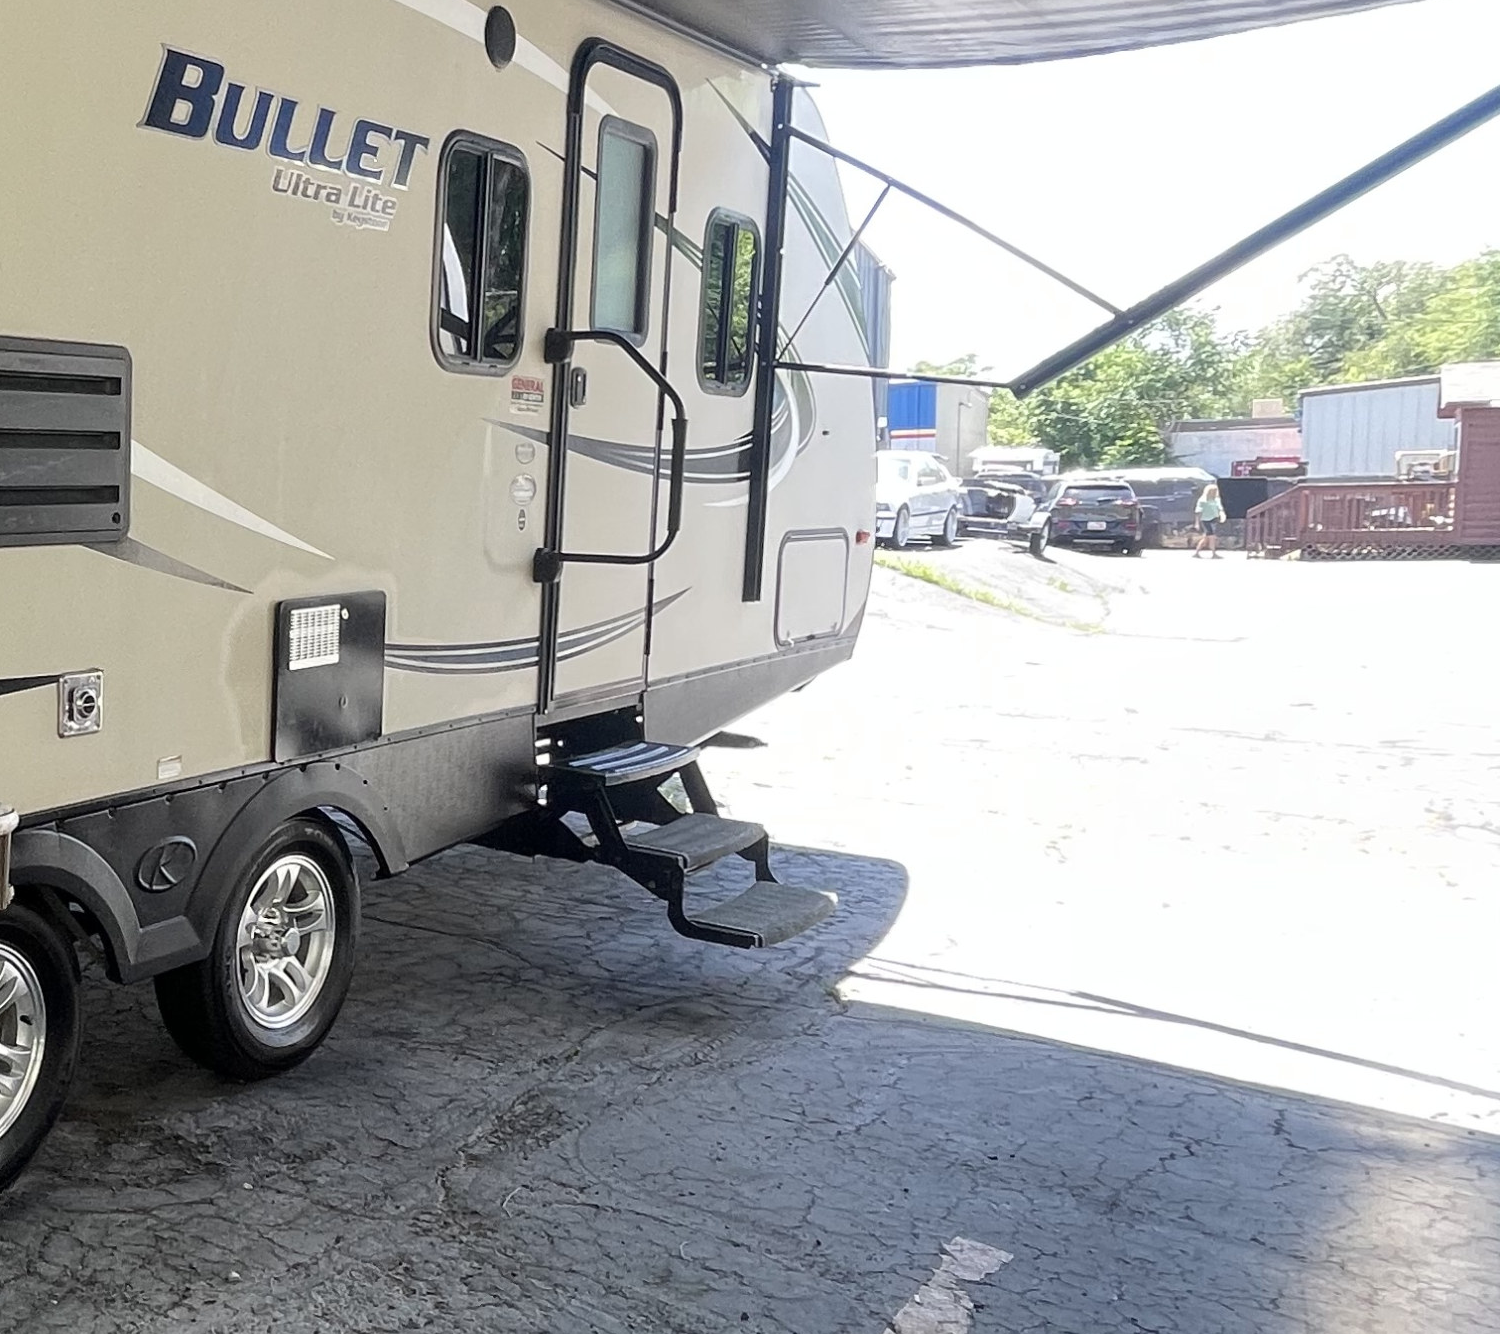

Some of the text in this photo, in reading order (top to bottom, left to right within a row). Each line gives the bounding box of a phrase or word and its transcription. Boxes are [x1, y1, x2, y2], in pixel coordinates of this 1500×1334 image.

[137, 43, 430, 190] BULLET
[272, 168, 397, 216] Ultra Lite
